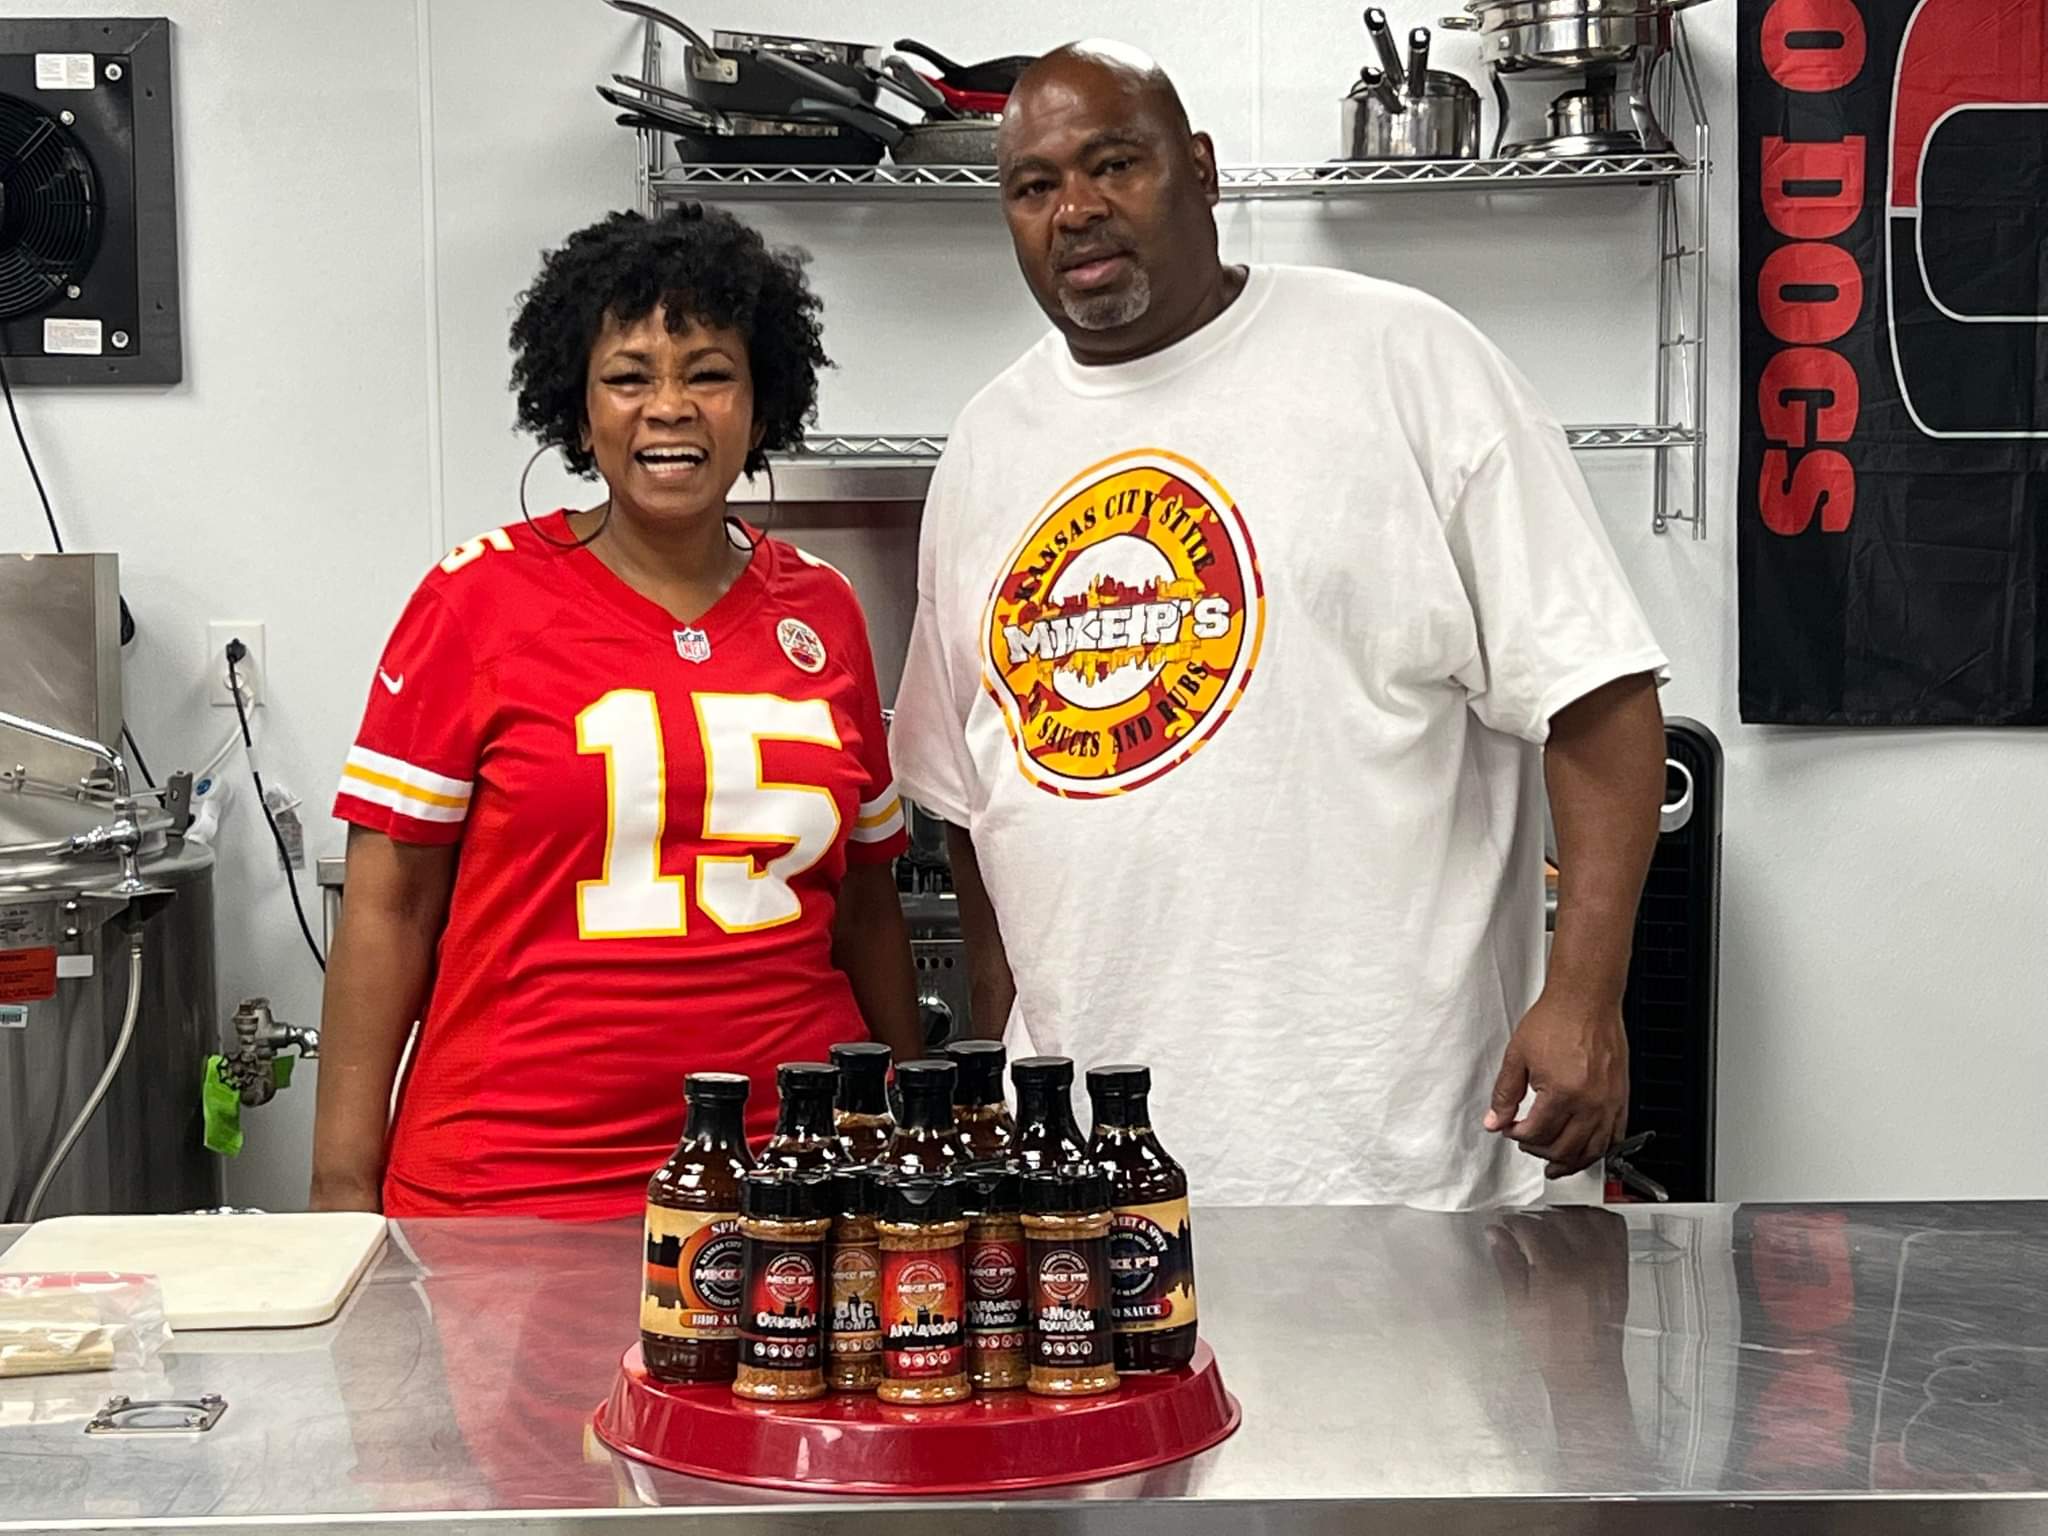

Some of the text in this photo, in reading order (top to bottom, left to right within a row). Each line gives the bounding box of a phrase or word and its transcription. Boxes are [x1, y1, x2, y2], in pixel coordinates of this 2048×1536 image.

[1756, 134, 1867, 537] DOGS
[1015, 488, 1216, 601] KANSAS CITY STYLE
[1037, 661, 1211, 758] SAUCES AND RUBS
[574, 688, 842, 940] 15
[756, 1311, 817, 1330] ORIGINAL
[835, 1301, 874, 1322] BIG
[1123, 1304, 1162, 1318] SAUCE
